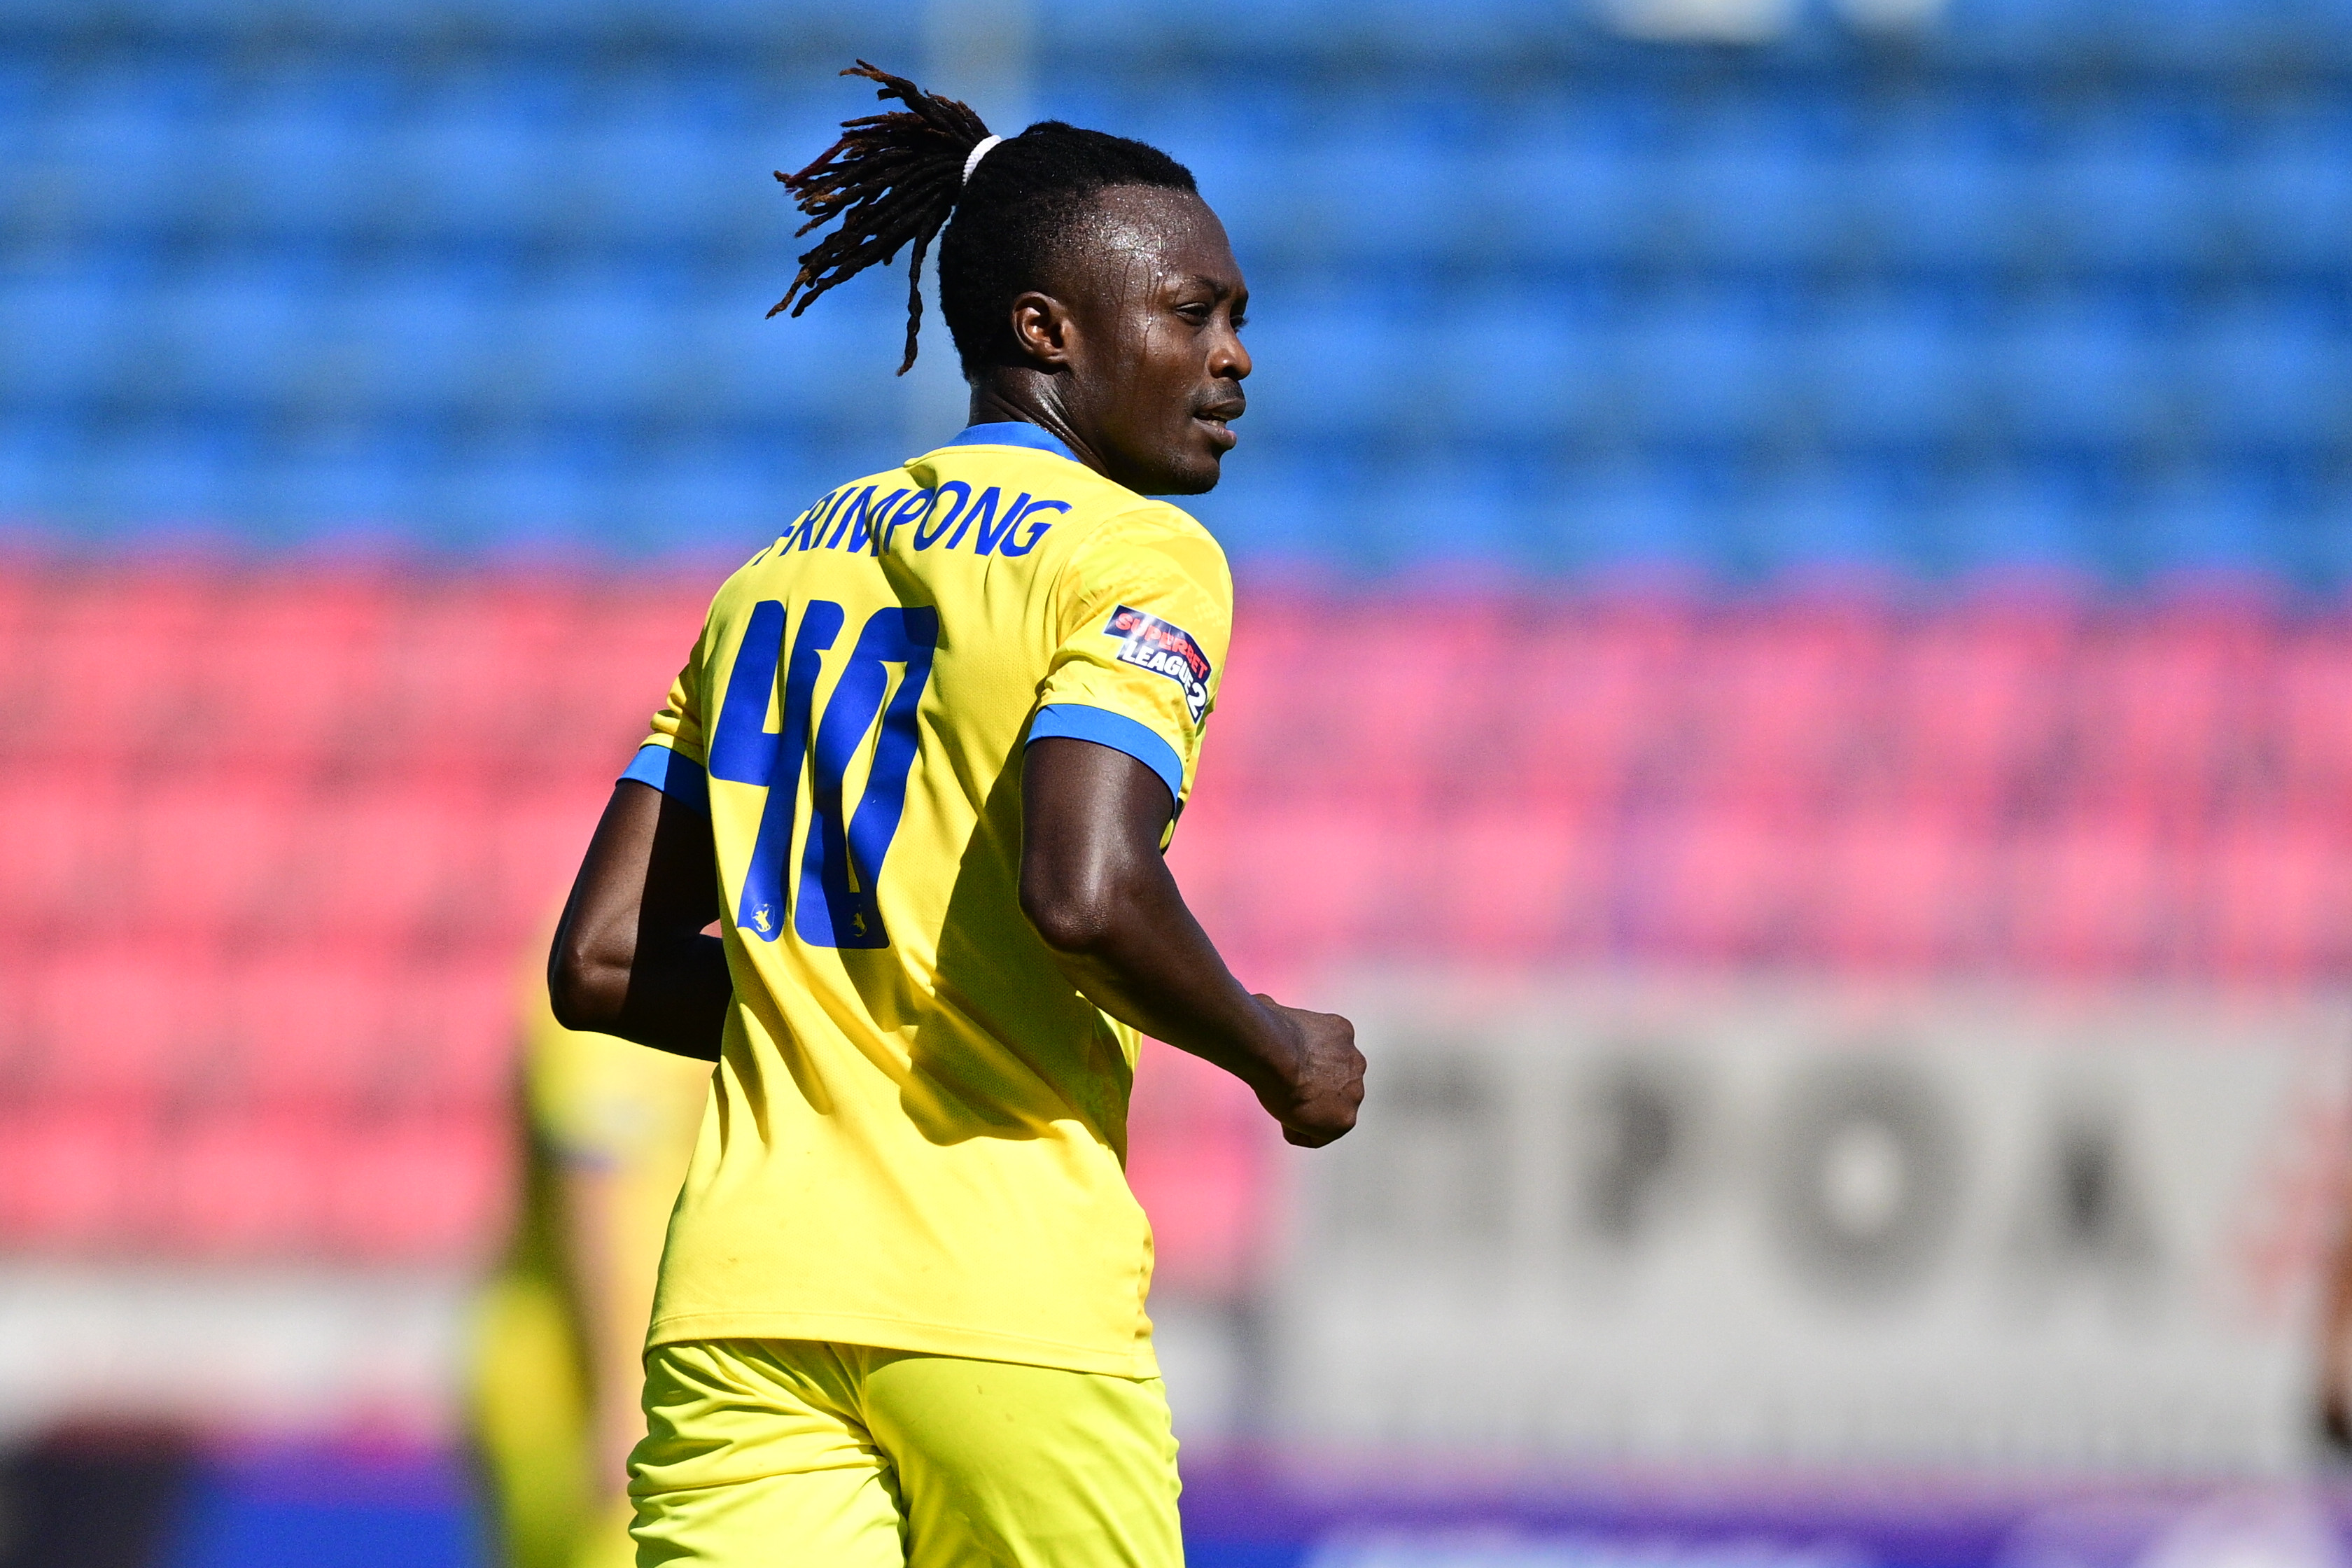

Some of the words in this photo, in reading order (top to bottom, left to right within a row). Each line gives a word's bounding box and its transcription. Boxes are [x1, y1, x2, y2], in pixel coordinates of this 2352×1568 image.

[1115, 612, 1208, 679] SUPERBET
[1122, 640, 1194, 694] LEAGUE
[1187, 682, 1207, 718] 2
[709, 599, 939, 948] 40
